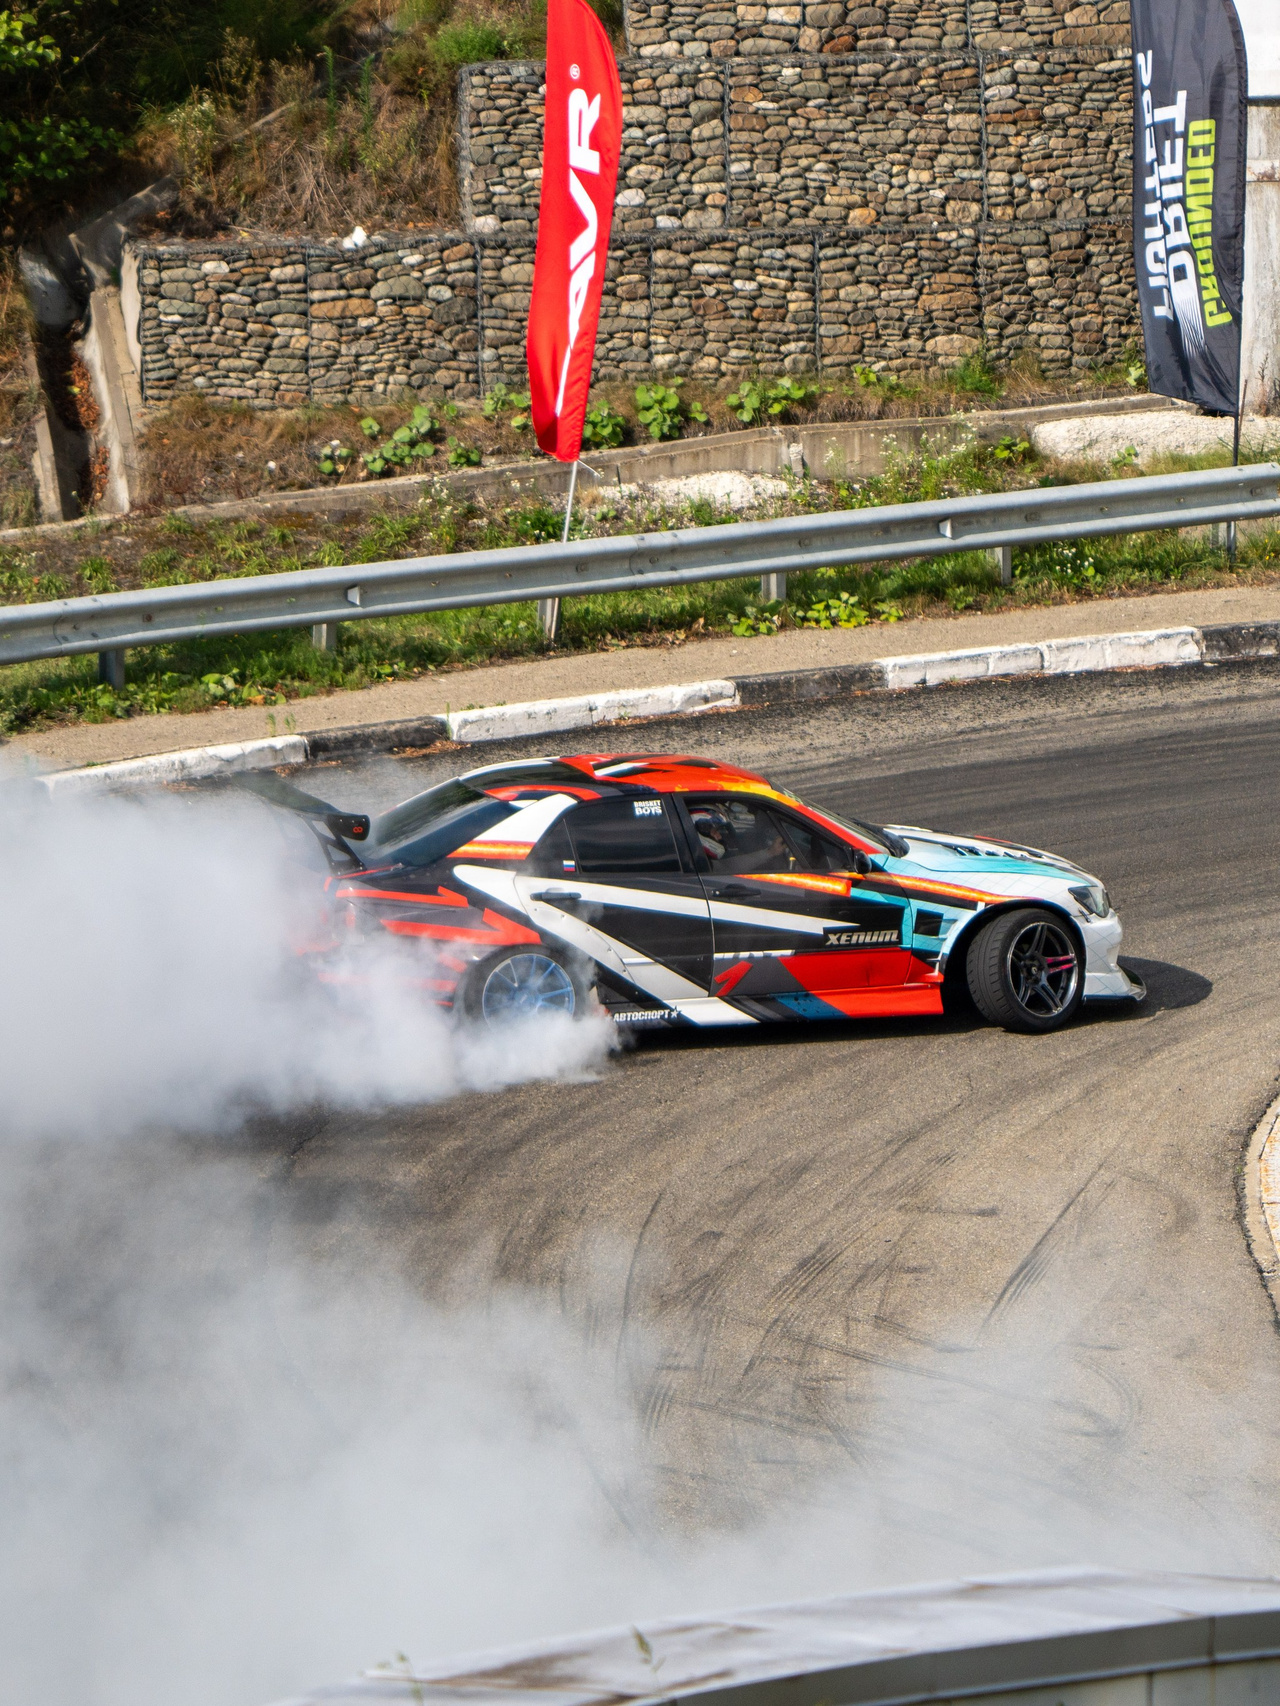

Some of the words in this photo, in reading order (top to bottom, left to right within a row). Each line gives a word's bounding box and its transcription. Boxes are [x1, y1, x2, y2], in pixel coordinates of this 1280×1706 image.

[635, 807, 662, 816] BOYS
[825, 929, 899, 946] XENUM
[613, 1009, 670, 1022] АВТОСПОРТ
